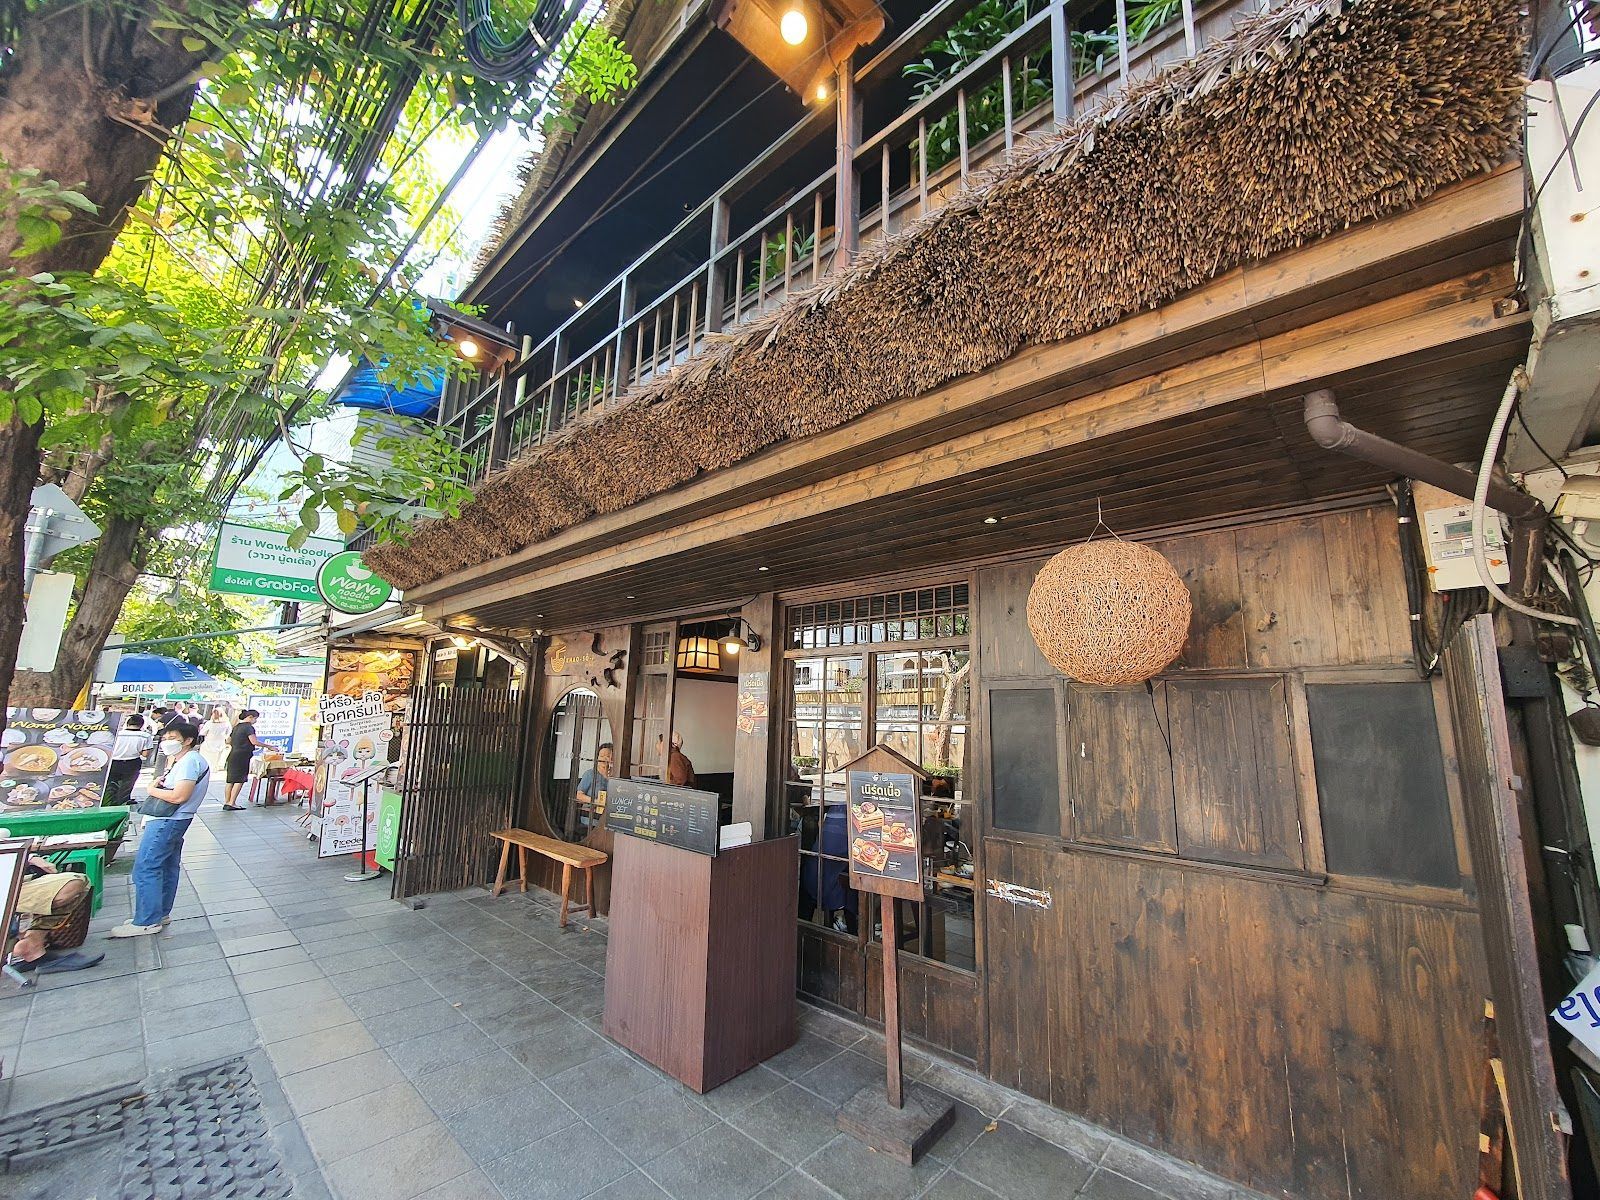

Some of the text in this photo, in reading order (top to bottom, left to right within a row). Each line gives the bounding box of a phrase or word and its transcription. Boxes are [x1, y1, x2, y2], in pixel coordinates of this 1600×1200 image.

[230, 535, 251, 547] ร้าน
[255, 539, 291, 552] Wawa
[337, 588, 370, 601] noodle
